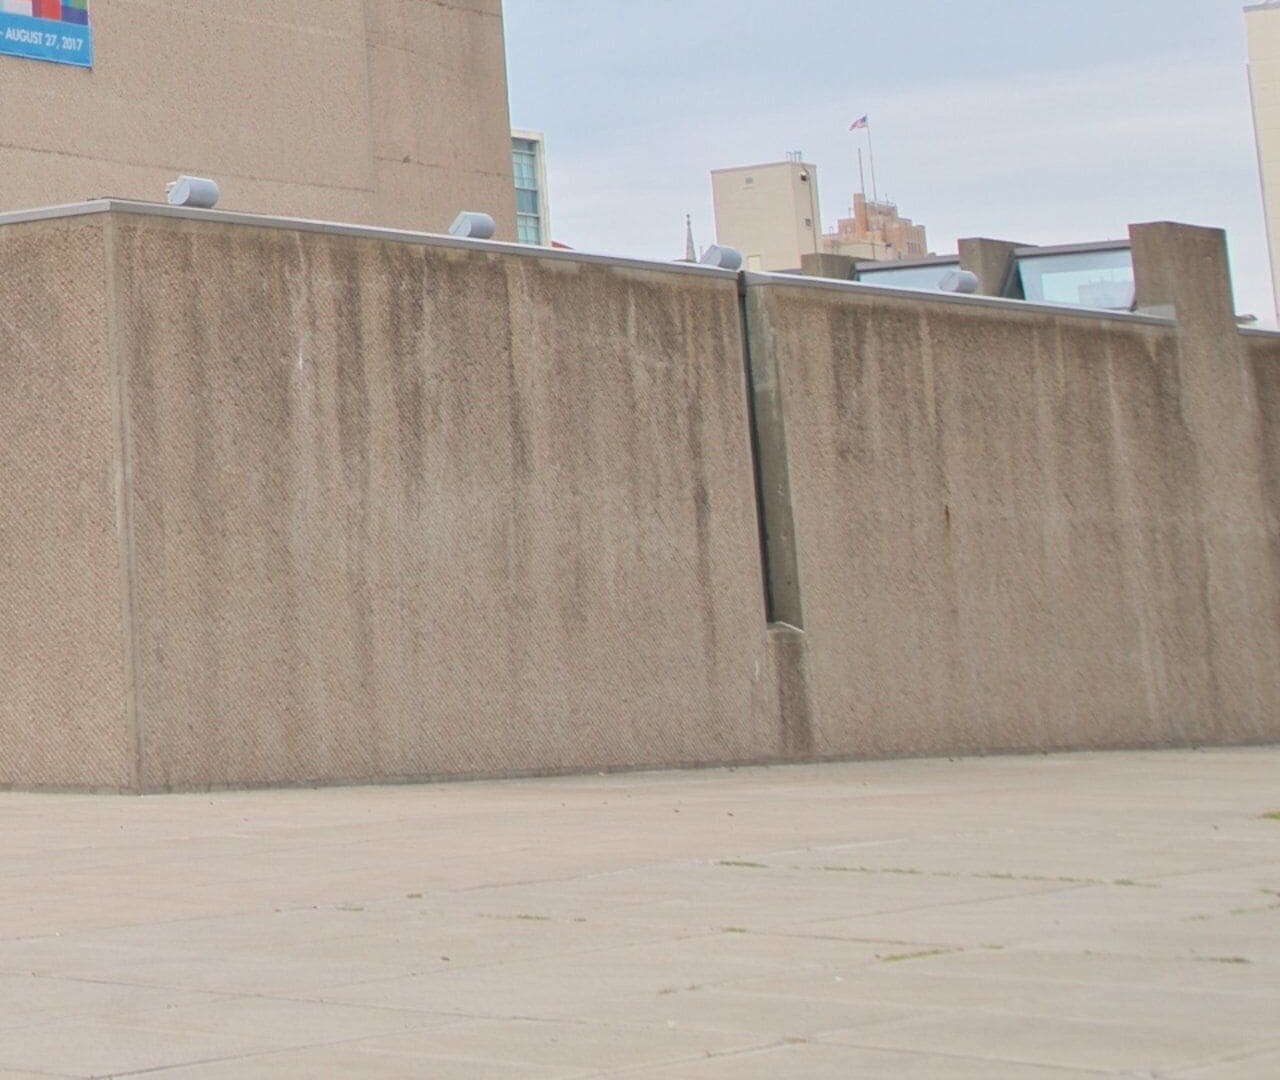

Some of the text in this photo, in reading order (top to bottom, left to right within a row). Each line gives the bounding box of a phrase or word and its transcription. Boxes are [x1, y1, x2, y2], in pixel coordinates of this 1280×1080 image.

[5, 27, 42, 46] AUGUST
[44, 34, 60, 49] 27,
[62, 36, 84, 51] 2017
